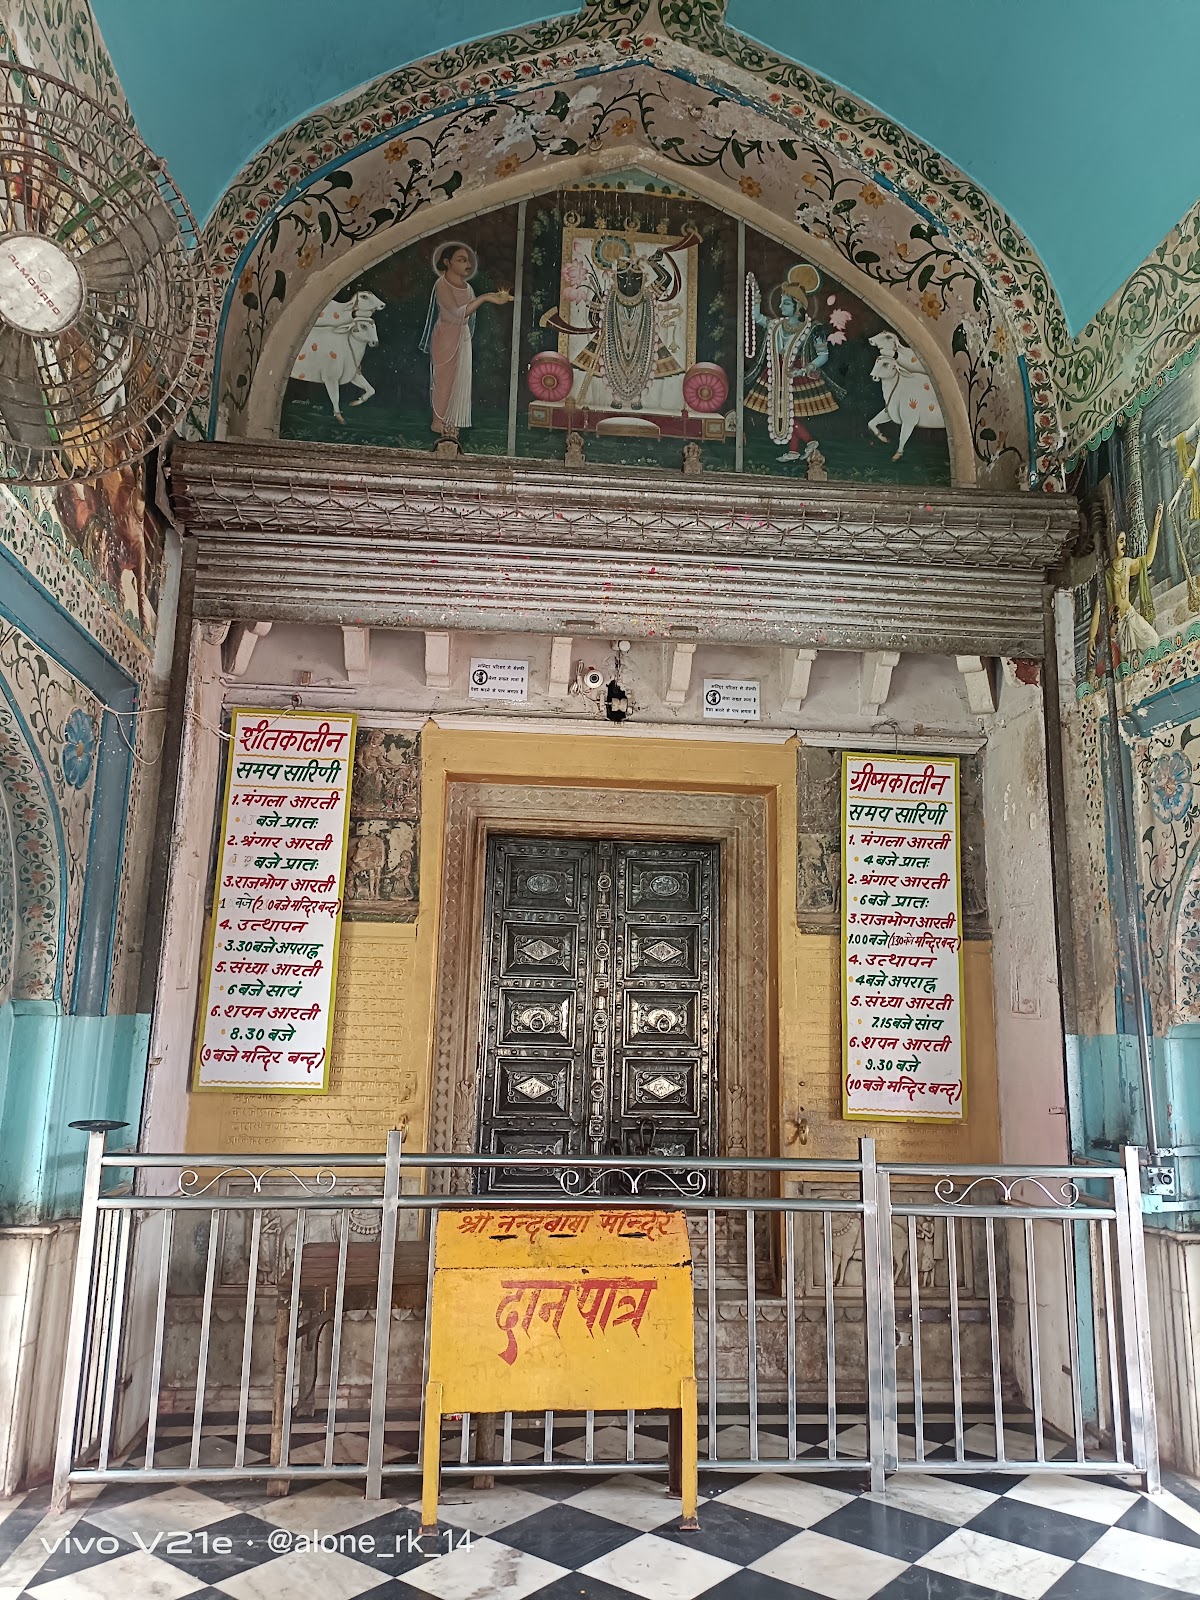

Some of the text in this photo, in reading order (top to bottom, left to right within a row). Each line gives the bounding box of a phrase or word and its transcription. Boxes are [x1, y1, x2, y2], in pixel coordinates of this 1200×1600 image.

[8, 254, 60, 316] ALMONARD
[239, 720, 348, 753] शीतकालीन
[236, 759, 342, 784] समय सारिणी
[850, 762, 951, 796] ग्रीष्मकालीन
[290, 791, 340, 810] आरती
[256, 811, 282, 828] बजे
[280, 816, 320, 830] प्रातः
[849, 802, 948, 826] समय सारिणी
[285, 834, 333, 851] आरती
[860, 831, 907, 848] मंगला
[907, 833, 952, 850] आरती
[254, 852, 282, 870] बजे
[280, 857, 319, 871] प्रातः
[875, 851, 899, 867] बजे
[899, 856, 930, 869] प्रातः
[290, 875, 336, 893] आरती
[900, 872, 950, 890] आरती
[891, 896, 929, 909] प्रातः
[237, 918, 308, 933] उत्थापन
[271, 959, 323, 977] आरती
[865, 953, 938, 968] उत्थापन
[238, 979, 266, 997] बजे
[906, 994, 954, 1011] आरती
[224, 1004, 267, 1019] शयन
[267, 1003, 321, 1021] आरती
[229, 1023, 296, 1041] 8.30 बजे
[902, 1035, 952, 1053] आरती
[240, 1045, 284, 1071] मन्दिर
[896, 1054, 921, 1073] बजे
[886, 1076, 927, 1102] मन्दिर
[457, 1212, 493, 1235] श्री
